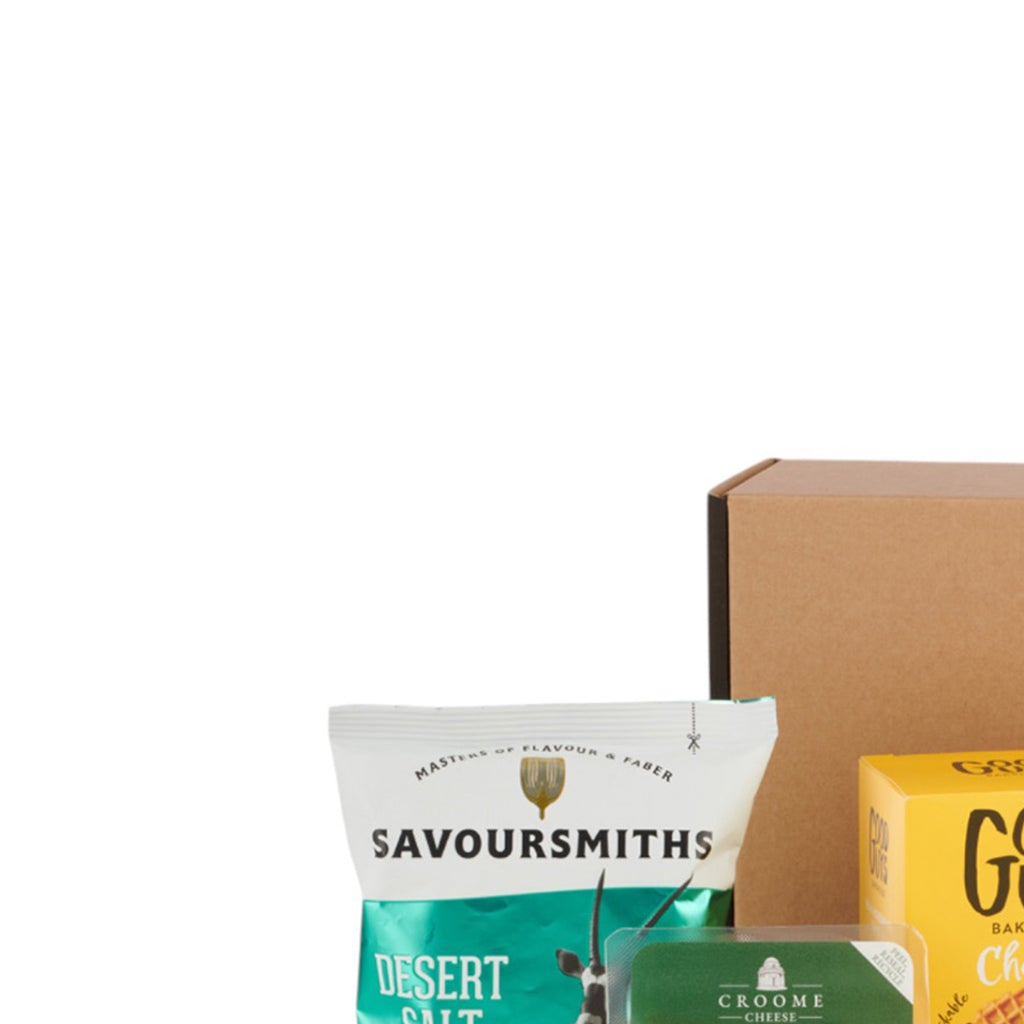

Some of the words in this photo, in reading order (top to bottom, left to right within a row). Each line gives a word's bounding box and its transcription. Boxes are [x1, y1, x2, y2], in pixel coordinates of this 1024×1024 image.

[415, 749, 488, 781] MASTERS
[523, 744, 598, 756] FLAVOUR
[623, 756, 674, 783] FABER
[372, 828, 714, 860] SAVOURSMITHS
[374, 953, 509, 1000] DESERT
[718, 994, 824, 1008] CROOME
[745, 1012, 797, 1023] CHEESE
